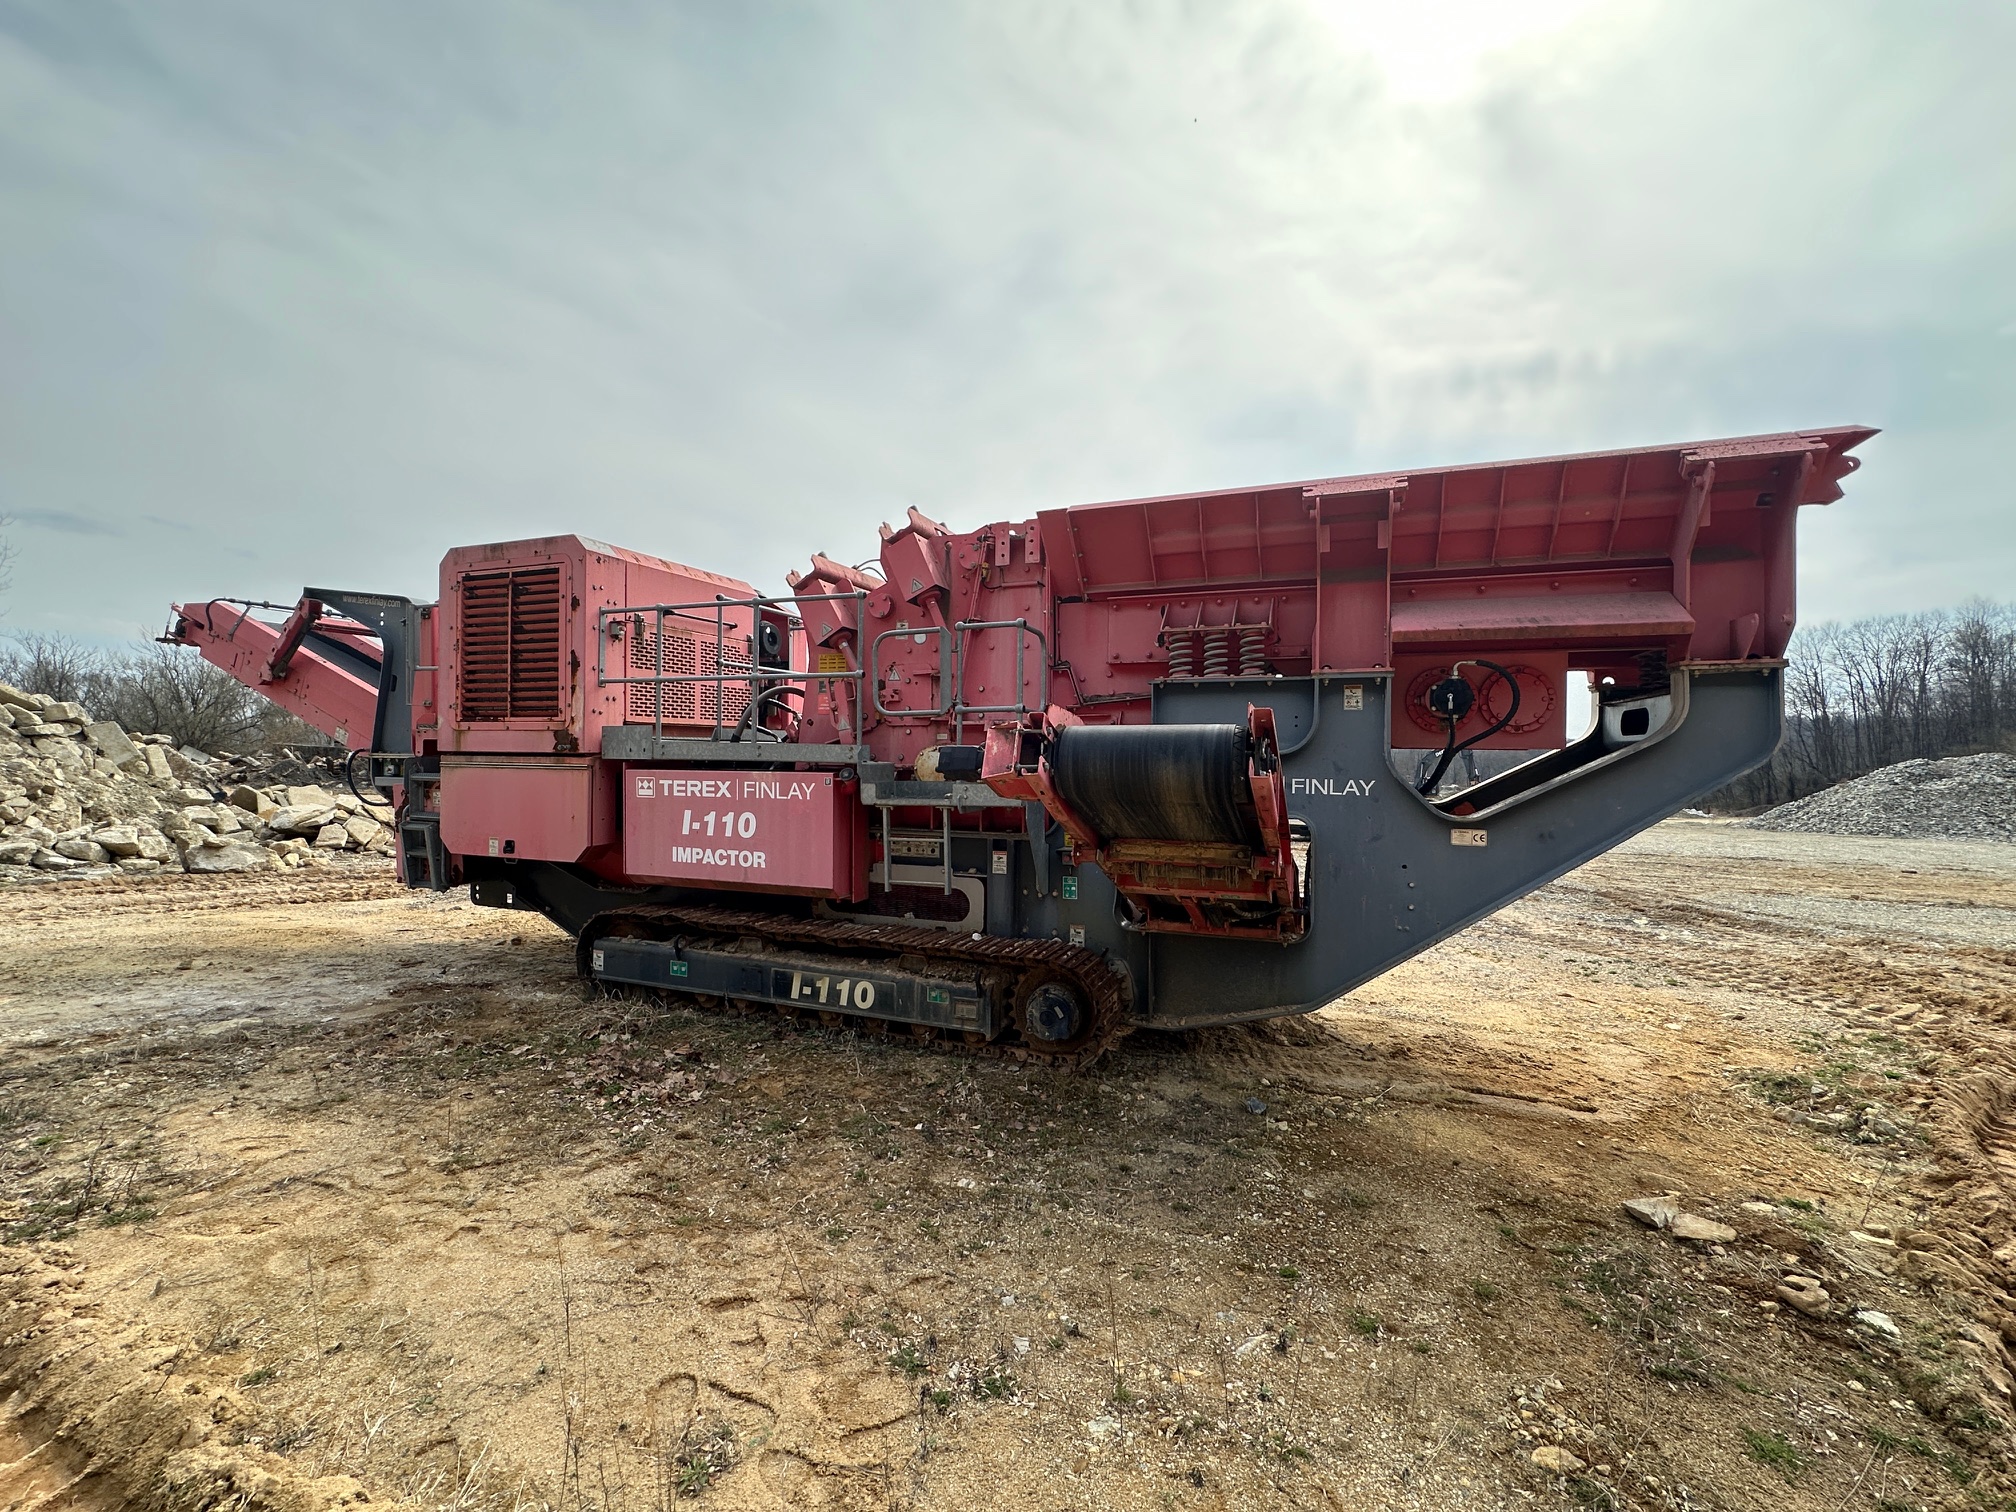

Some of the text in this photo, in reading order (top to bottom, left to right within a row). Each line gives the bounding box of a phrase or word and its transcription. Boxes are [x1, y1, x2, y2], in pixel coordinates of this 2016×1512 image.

[342, 594, 401, 609] www.terexfinlay.com
[659, 779, 816, 800] TEREX FINLAY
[1291, 778, 1376, 796] FINLAY
[681, 809, 757, 839] I-110
[672, 846, 766, 869] IMPACTOR
[790, 972, 875, 1010] I-110
